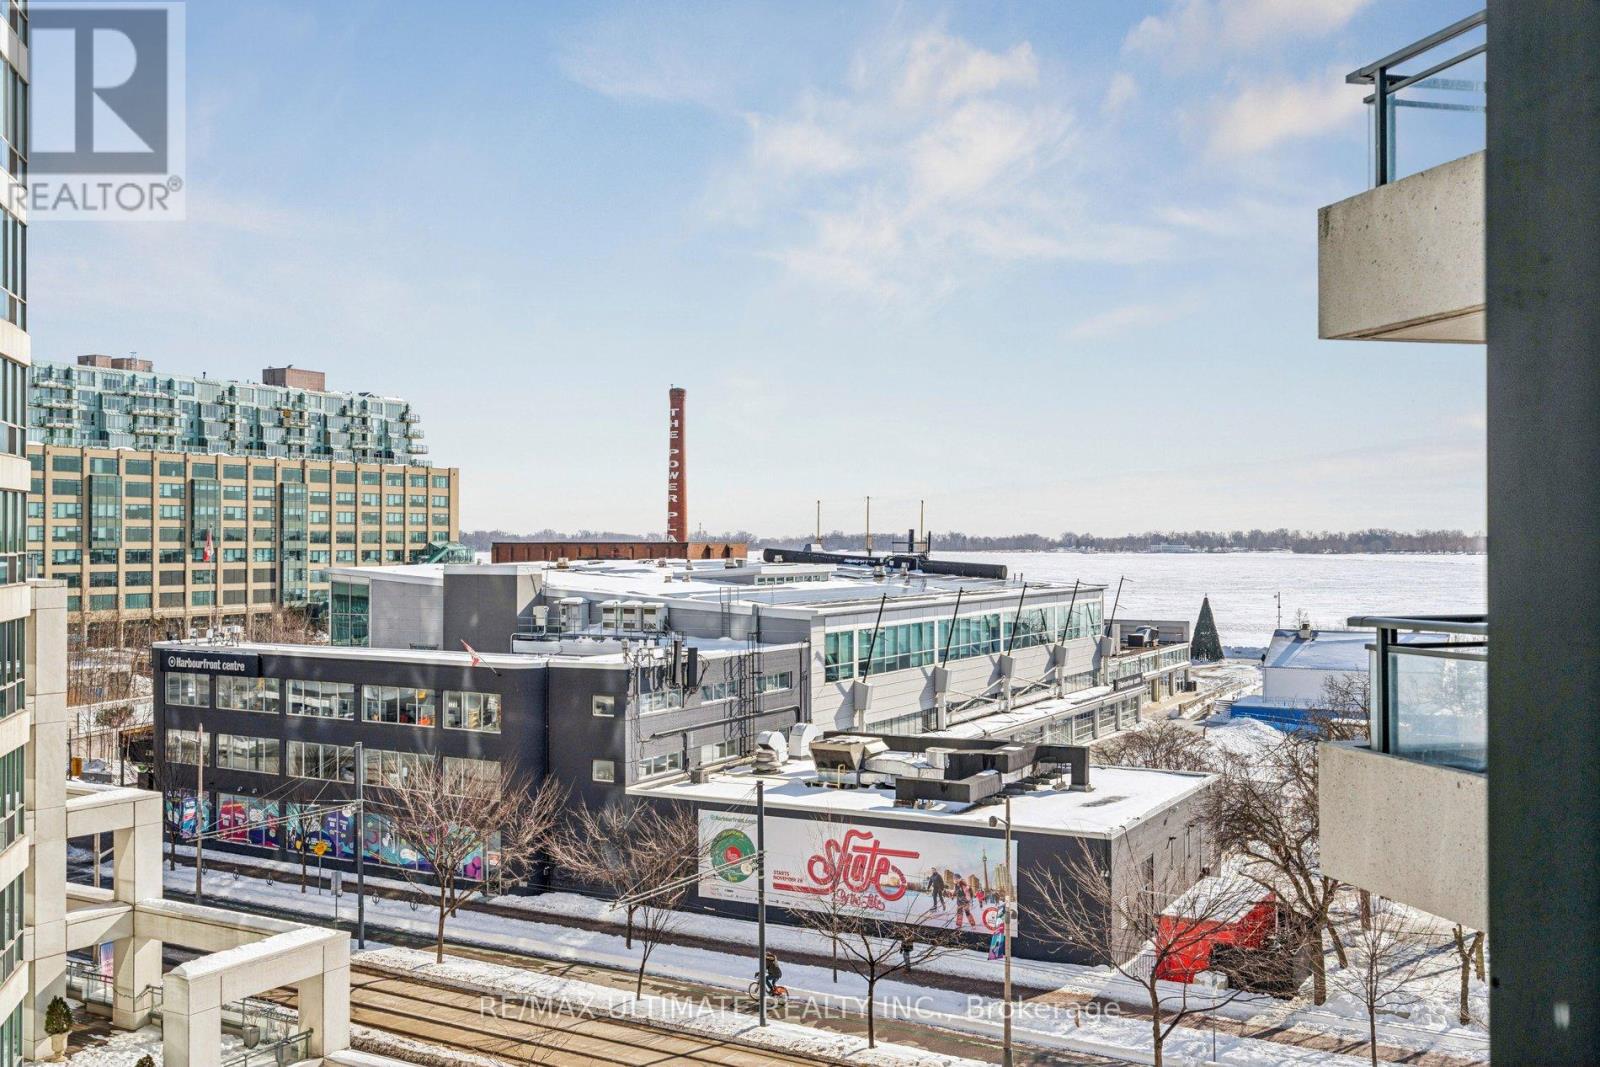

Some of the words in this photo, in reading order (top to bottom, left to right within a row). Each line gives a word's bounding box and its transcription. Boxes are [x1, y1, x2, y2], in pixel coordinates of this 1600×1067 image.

[669, 408, 680, 439] THE
[668, 449, 680, 503] POWER
[176, 657, 221, 670] Harbourfront
[222, 661, 245, 672] centre
[806, 828, 920, 901] Skate
